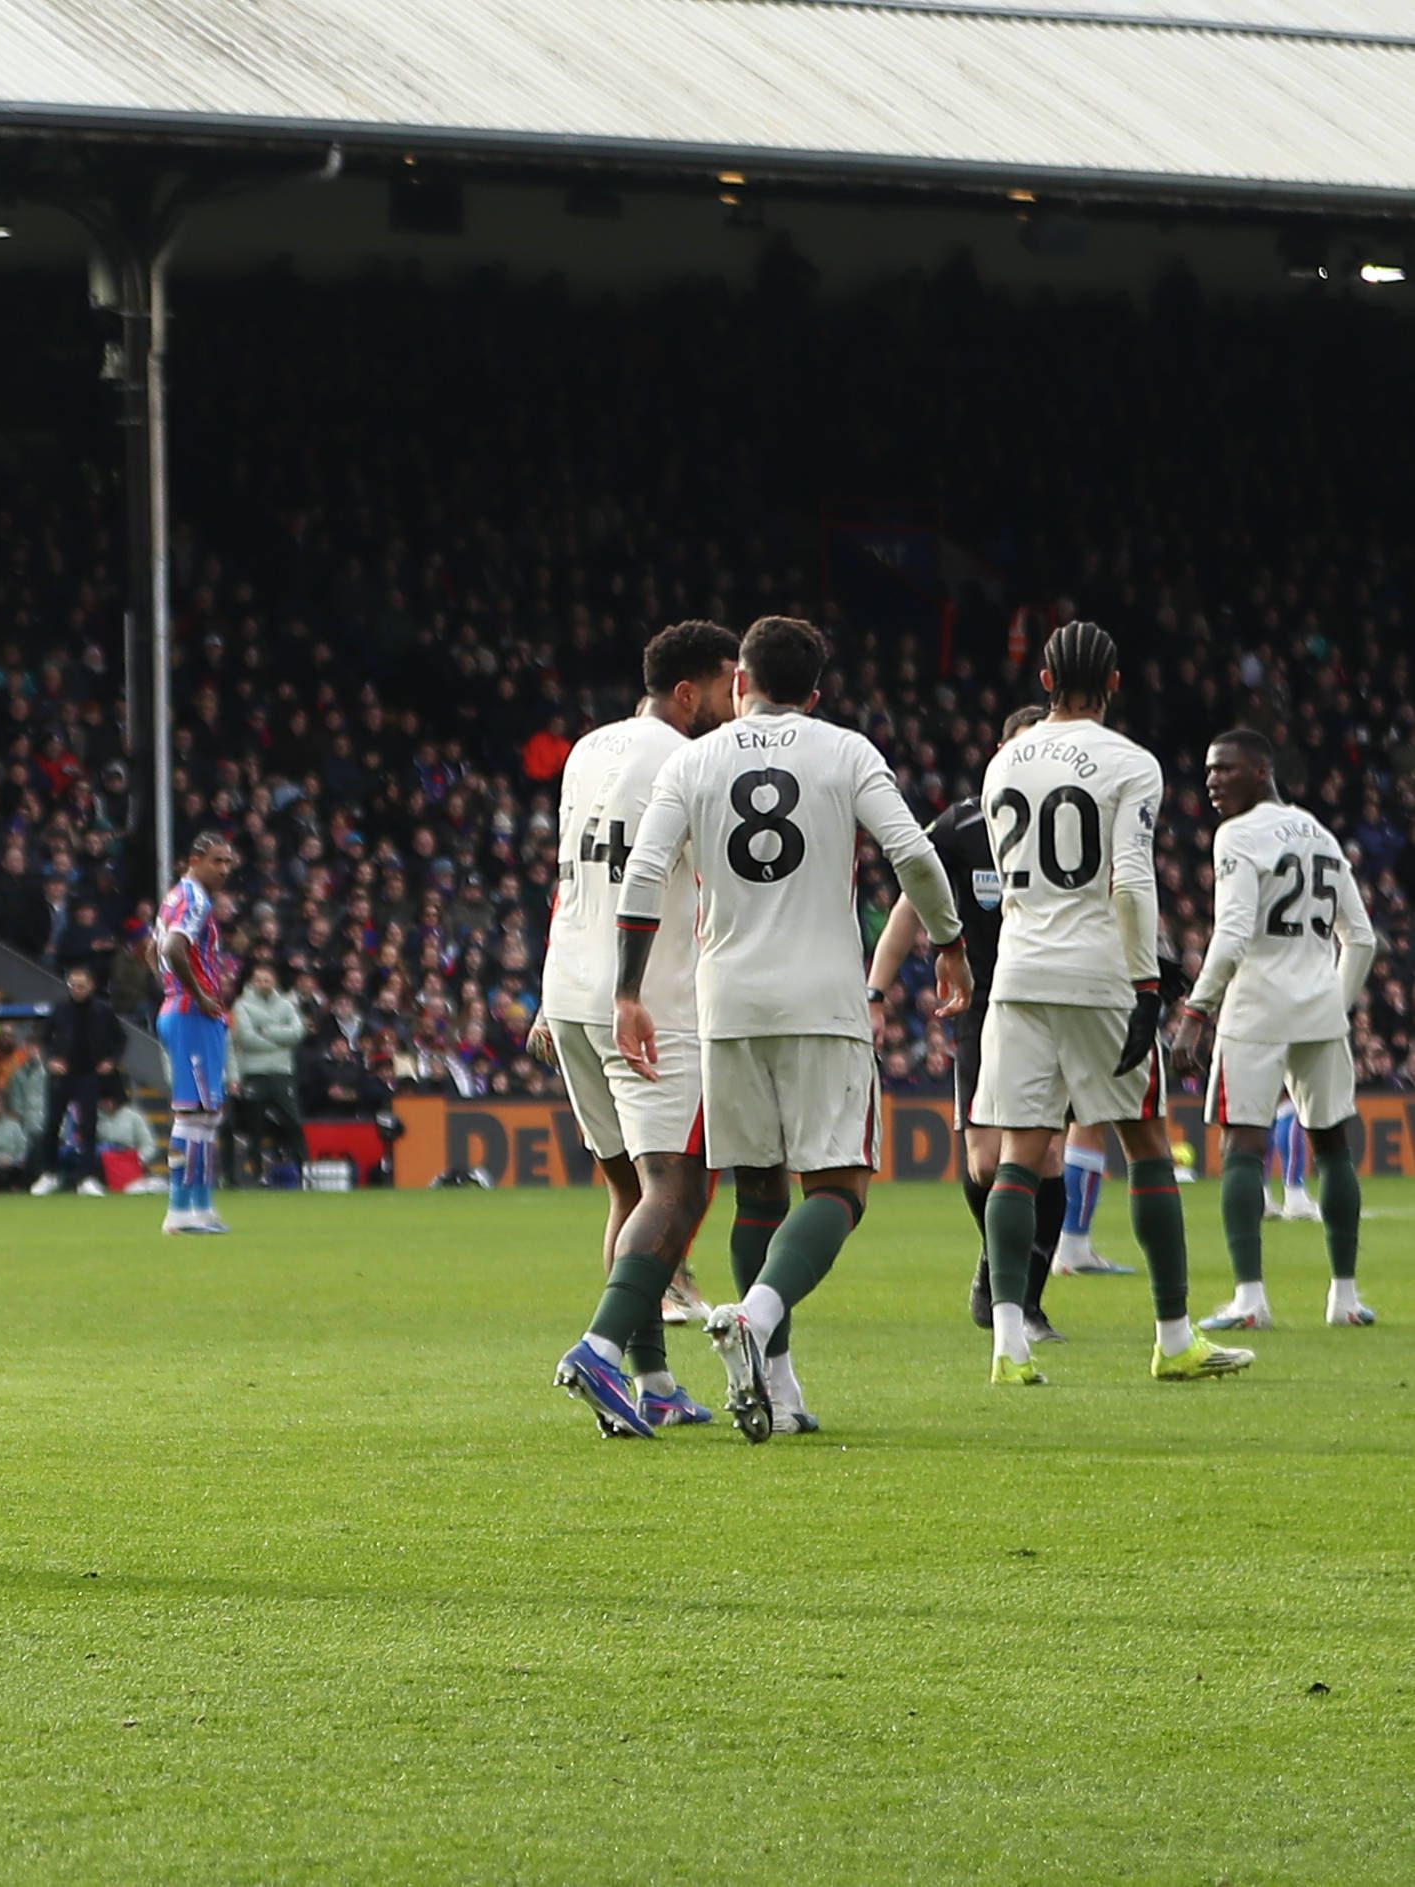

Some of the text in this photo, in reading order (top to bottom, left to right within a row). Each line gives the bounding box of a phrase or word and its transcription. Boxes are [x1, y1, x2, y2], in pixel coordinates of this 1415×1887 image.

[736, 729, 797, 749] ENZO
[1040, 740, 1098, 779] PEDRO
[727, 766, 806, 883] 8
[990, 784, 1102, 890] 20
[1266, 852, 1341, 941] 25
